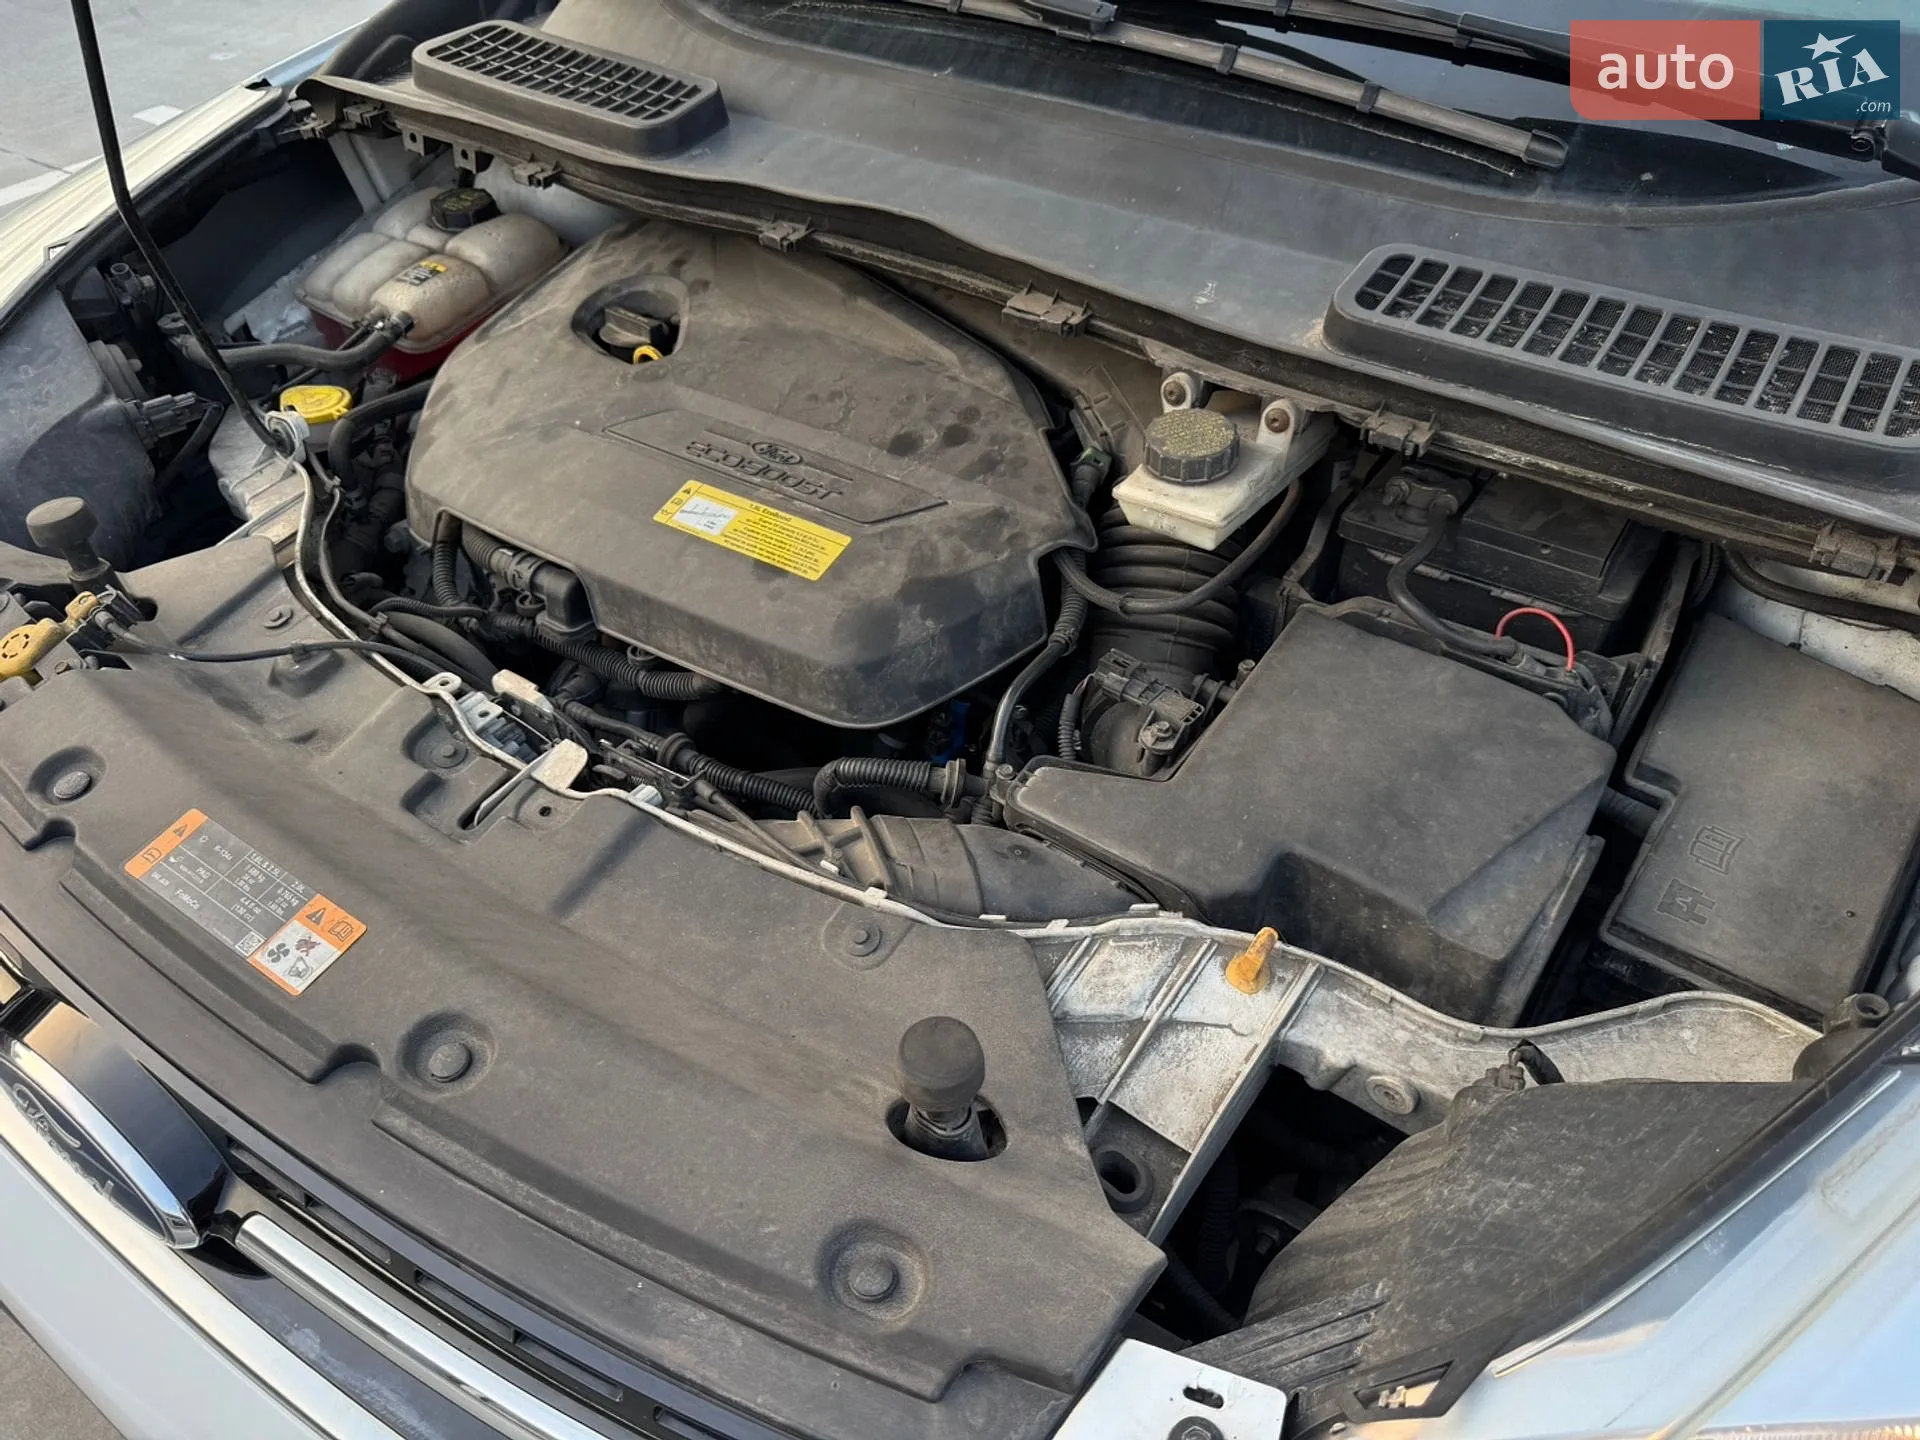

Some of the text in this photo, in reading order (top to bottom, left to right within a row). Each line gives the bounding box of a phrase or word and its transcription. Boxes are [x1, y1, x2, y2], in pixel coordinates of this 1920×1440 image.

[758, 445, 798, 465] Ford
[686, 441, 843, 500] ECOBOOST
[174, 888, 201, 909] FoMoCo
